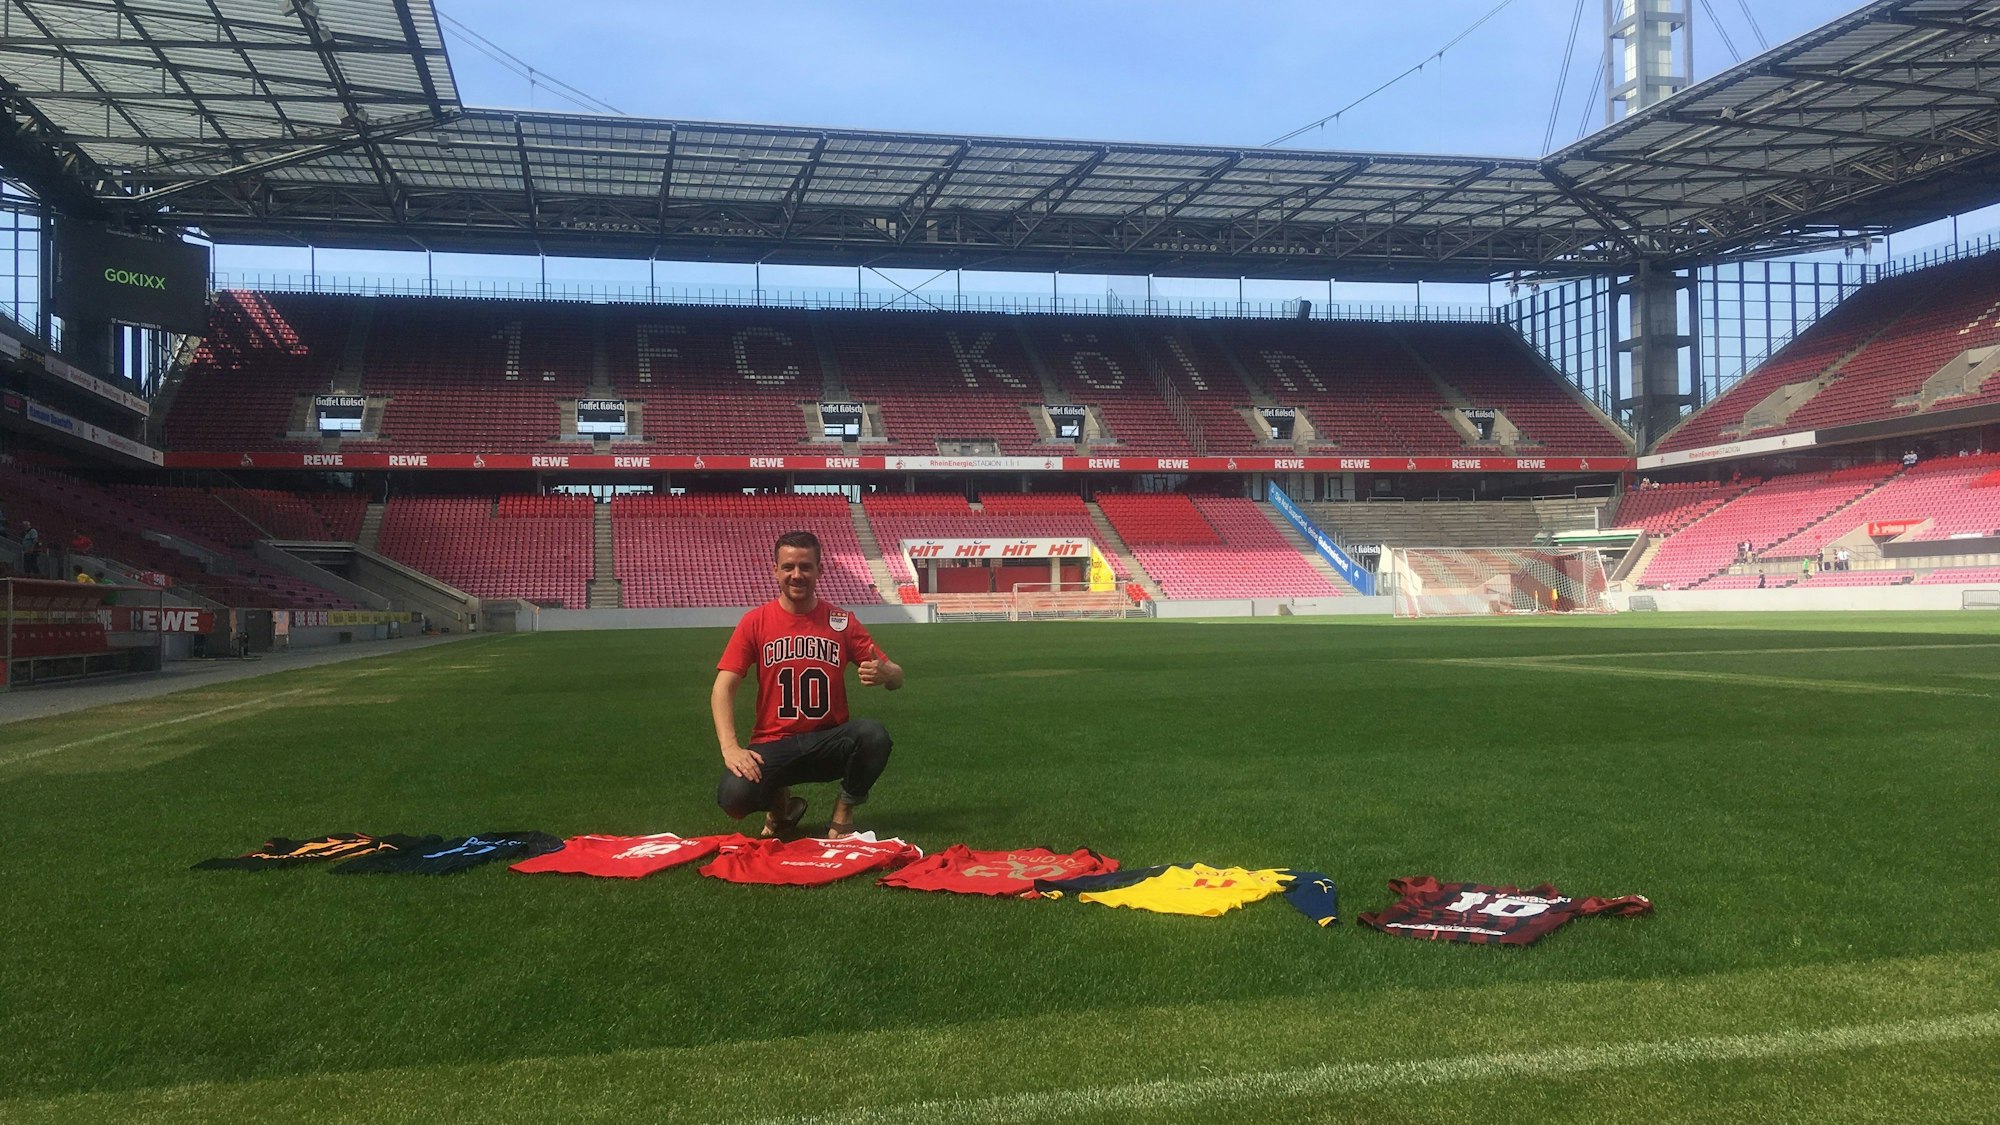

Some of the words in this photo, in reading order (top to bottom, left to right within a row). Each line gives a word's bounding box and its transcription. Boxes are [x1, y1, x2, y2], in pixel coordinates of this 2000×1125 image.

[104, 268, 166, 290] GOKIXX
[636, 324, 800, 385] FC
[947, 331, 1328, 392] Köln
[340, 397, 366, 407] Kölsch
[600, 401, 624, 411] Kölsch
[839, 405, 862, 414] Kölsch
[1064, 407, 1085, 416] Kölsch
[304, 455, 343, 466] REWE
[389, 456, 428, 466] REWE
[532, 456, 569, 467] REWE
[614, 456, 651, 468] REWE
[749, 457, 785, 468] REWE
[825, 458, 860, 468] REWE
[1088, 458, 1121, 469] REWE
[1157, 459, 1189, 469] REWE
[1274, 460, 1305, 469] REWE
[1340, 460, 1370, 469] REWE
[1452, 460, 1481, 469] REWE
[1516, 460, 1546, 469] REWE
[909, 544, 944, 557] HIT
[955, 544, 991, 557] HIT
[1002, 544, 1037, 556] HIT
[1048, 543, 1083, 556] HIT
[131, 611, 199, 632] REWE
[763, 637, 840, 667] COLOGNE
[777, 667, 831, 720] 10
[1446, 892, 1551, 917] 10
